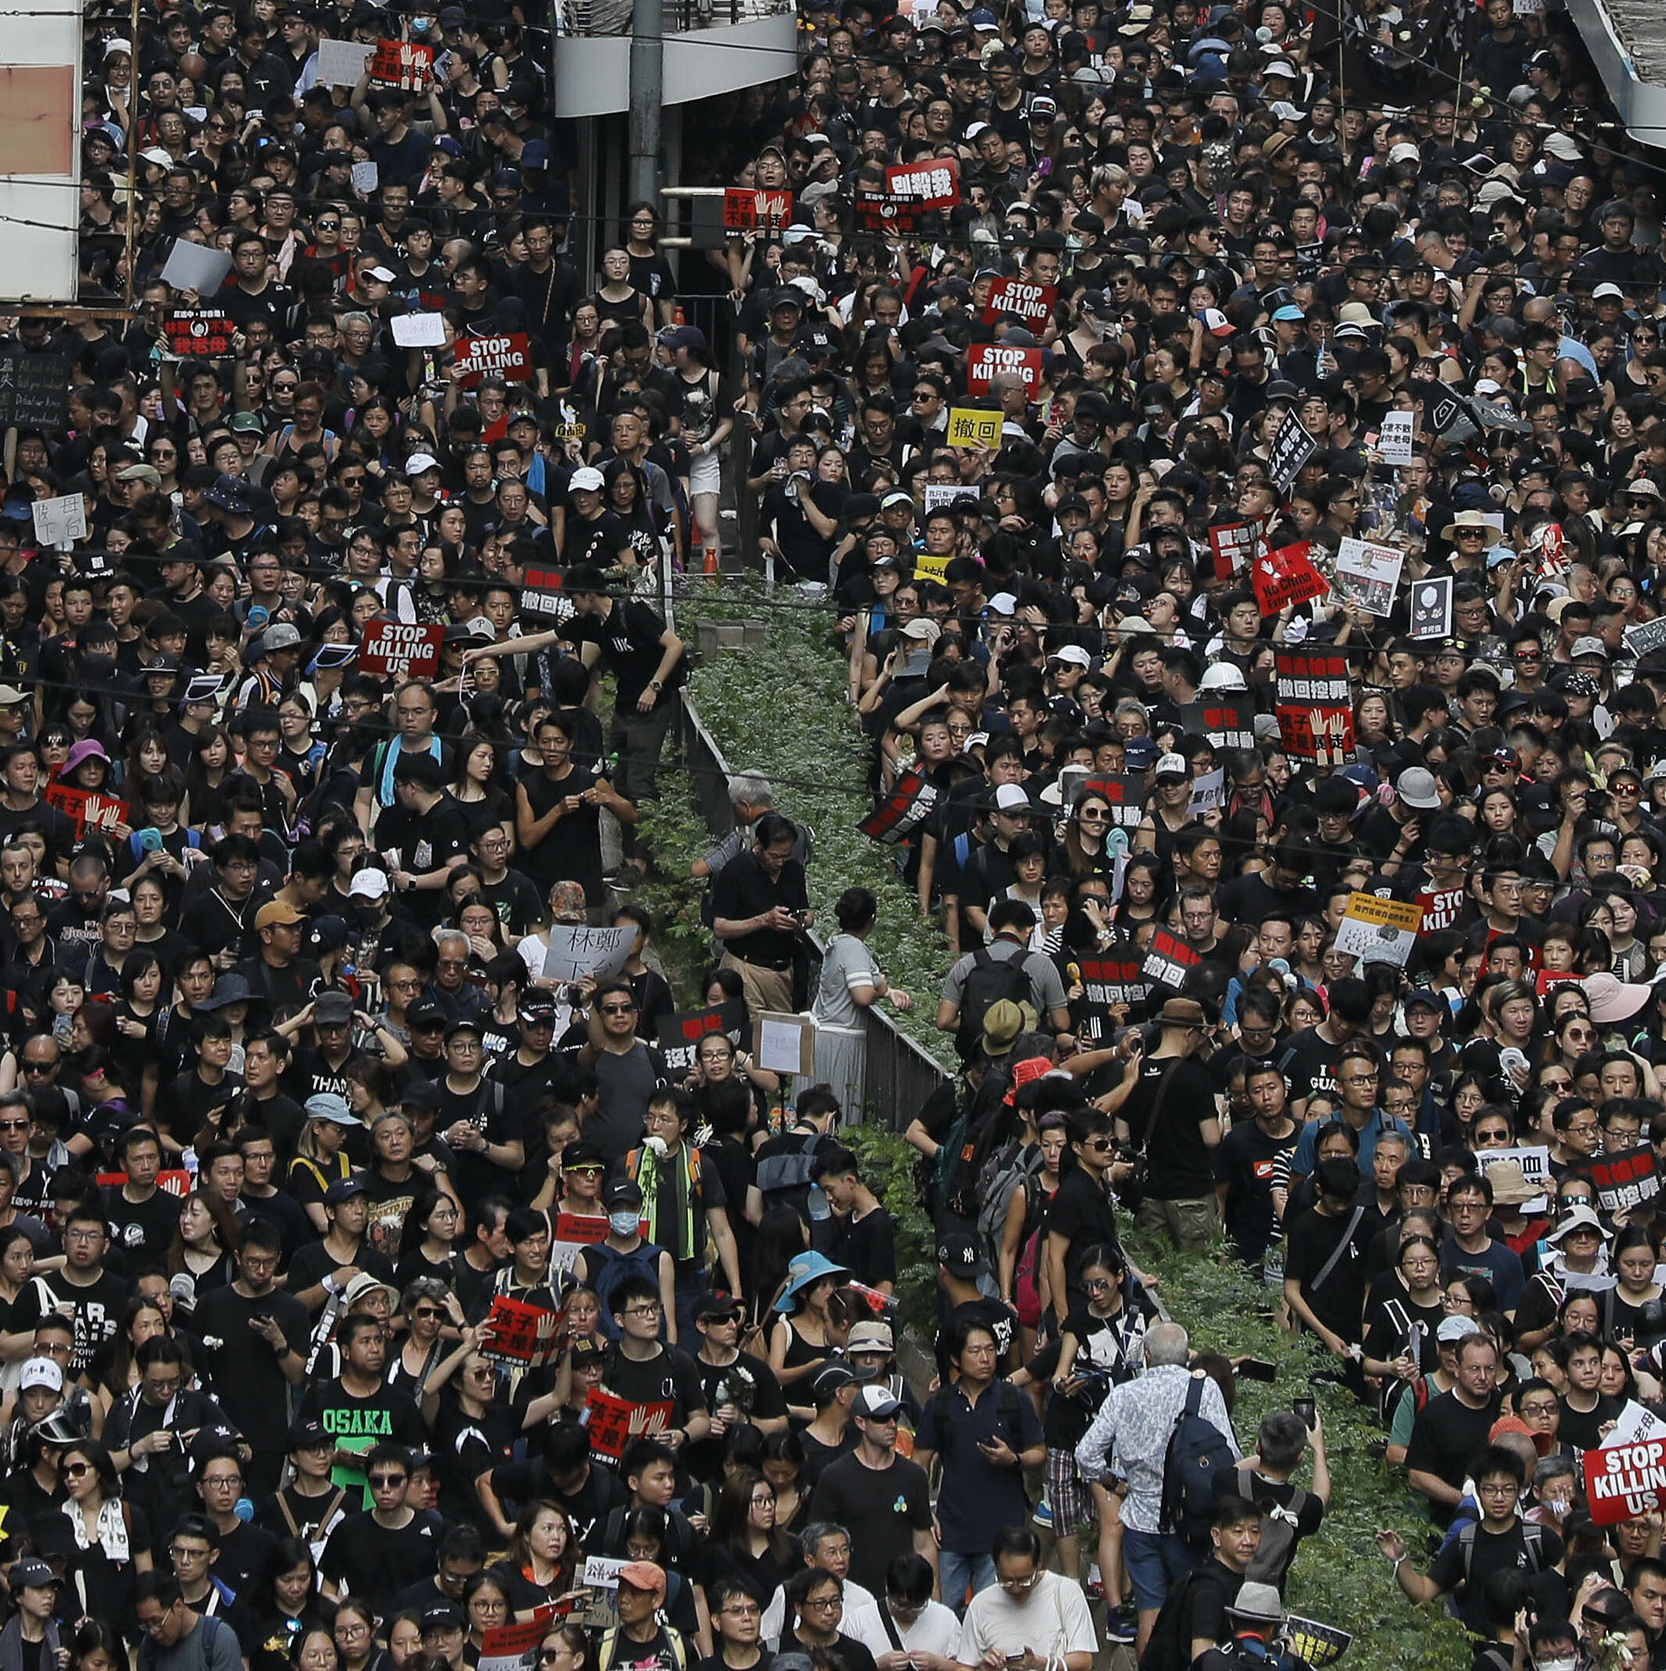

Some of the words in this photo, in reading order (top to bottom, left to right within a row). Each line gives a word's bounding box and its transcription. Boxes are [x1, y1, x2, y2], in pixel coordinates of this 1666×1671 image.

[1005, 280, 1044, 300] STOP
[990, 292, 1048, 320] KILLING
[469, 337, 512, 357] STOP
[984, 347, 1026, 365] STOP
[461, 351, 524, 370] KILLING
[953, 417, 997, 439] 撤回
[381, 624, 428, 642] STOP
[367, 640, 434, 659] KILLING
[385, 658, 411, 675] US
[568, 927, 623, 954] 林鄭
[322, 1409, 394, 1436] OSAKA
[1605, 1442, 1665, 1470] STOP
[1624, 1490, 1660, 1511] US
